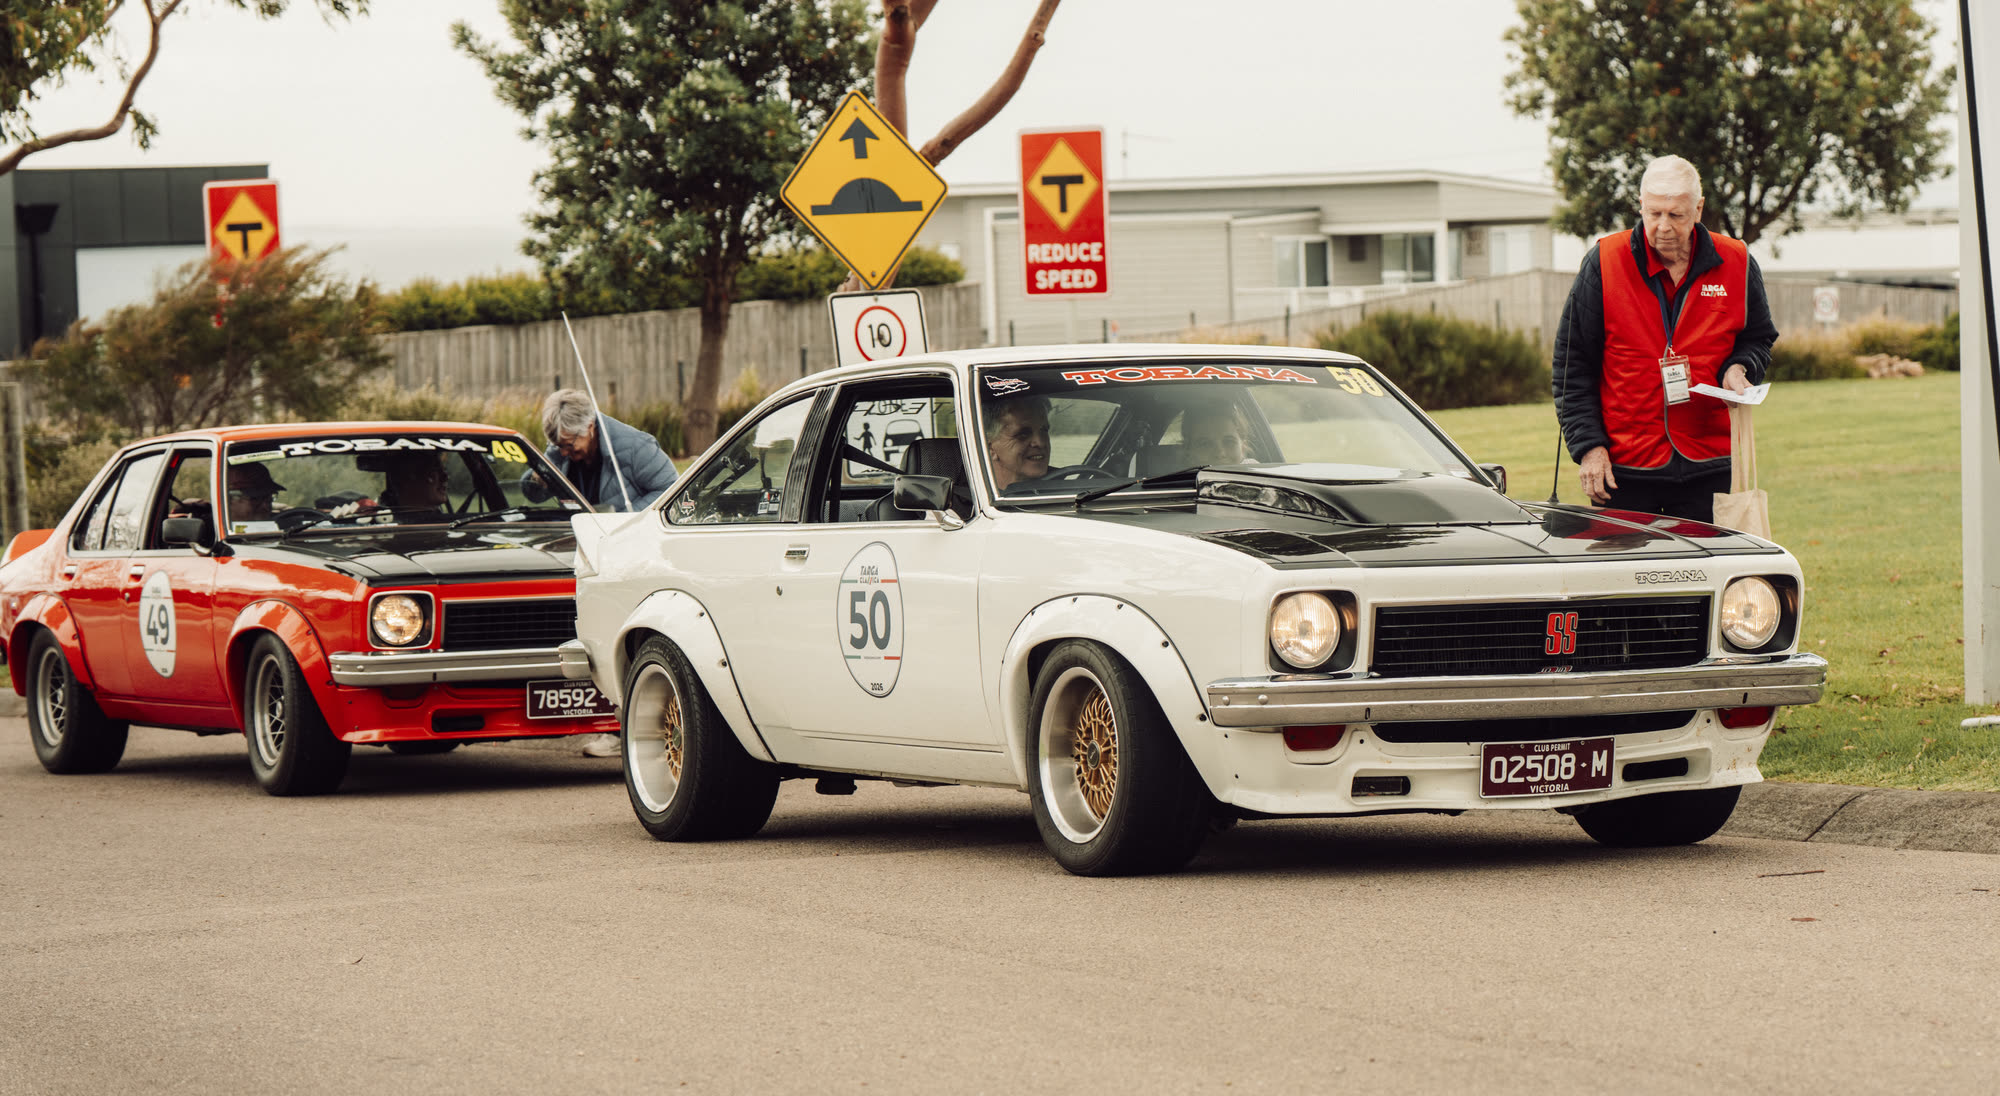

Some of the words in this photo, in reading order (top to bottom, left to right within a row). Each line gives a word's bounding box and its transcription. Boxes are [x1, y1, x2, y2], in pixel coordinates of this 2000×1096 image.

[1027, 242, 1104, 264] REDUCE
[1035, 268, 1098, 290] SPEED
[867, 323, 892, 349] 10
[1061, 366, 1318, 386] TORANA
[1325, 365, 1385, 398] 50
[279, 438, 488, 456] TORANA
[491, 440, 528, 464] 49
[860, 565, 879, 576] TARGA
[1635, 570, 1708, 585] TORANA
[146, 604, 170, 646] 49
[850, 590, 891, 651] 50
[1545, 612, 1579, 655] SS
[870, 682, 884, 691] 2026
[533, 688, 597, 709] 78592
[1533, 744, 1549, 753] CLUB
[1550, 743, 1571, 752] PERMIT
[1529, 783, 1570, 793] VICTORIA
